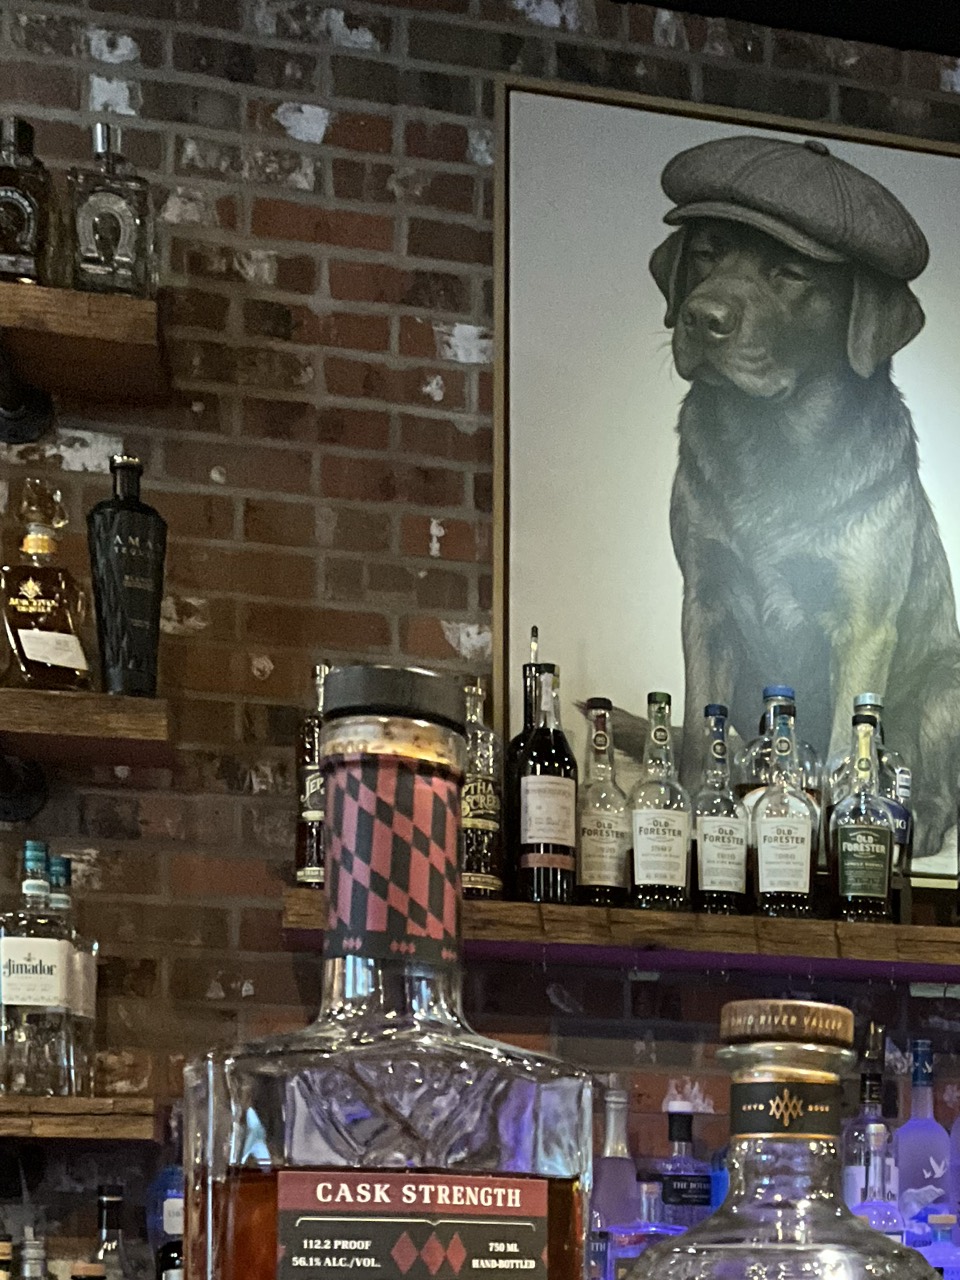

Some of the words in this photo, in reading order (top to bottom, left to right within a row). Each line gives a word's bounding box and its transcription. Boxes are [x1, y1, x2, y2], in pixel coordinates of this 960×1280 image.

[596, 821, 612, 829] OLD
[582, 827, 625, 838] FORESTER
[639, 827, 682, 836] FORESTER
[704, 834, 744, 845] FORESTER
[763, 835, 805, 844] FORESTER
[857, 835, 873, 843] OLD
[842, 842, 886, 853] FORESTER
[760, 1015, 797, 1026] RIVER
[316, 1183, 392, 1204] CASK
[402, 1184, 521, 1207] STRENGTH
[303, 1240, 331, 1250] 112.2
[334, 1240, 371, 1250] PROOF
[489, 1242, 505, 1252] 750
[507, 1243, 519, 1252] ML
[292, 1257, 322, 1267] 56.1%
[324, 1257, 381, 1268] ALC./VOL.
[472, 1258, 536, 1269] HAND-BOTTLED
